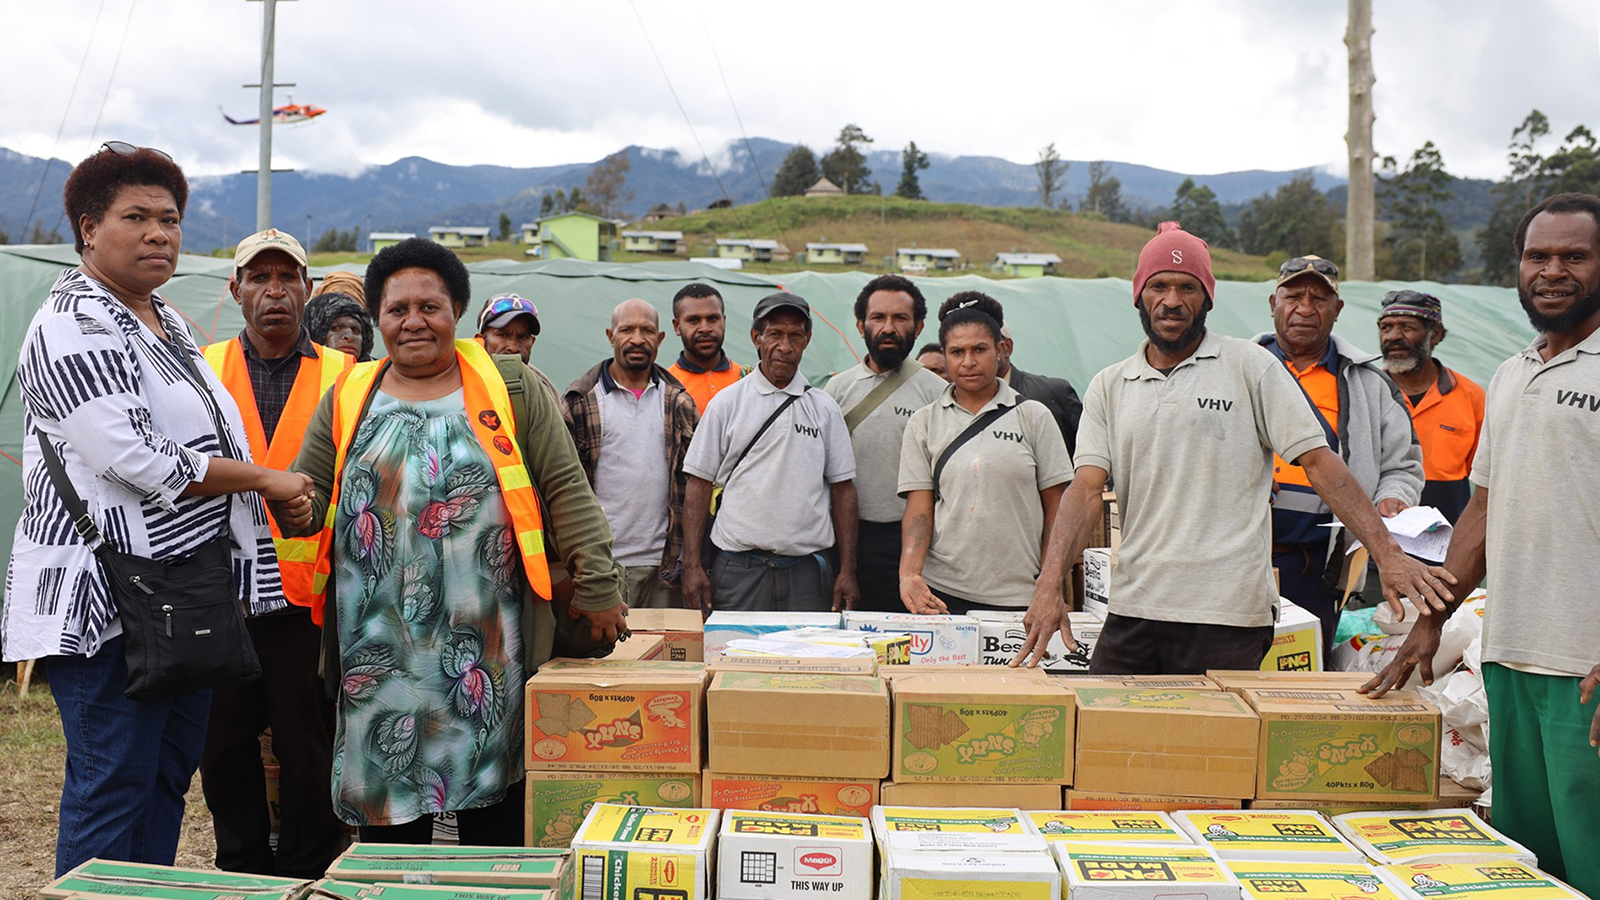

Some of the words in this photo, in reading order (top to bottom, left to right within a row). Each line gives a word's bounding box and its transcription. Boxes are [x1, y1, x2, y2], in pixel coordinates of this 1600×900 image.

[1171, 249, 1184, 264] S
[1197, 398, 1233, 413] VHV
[1557, 389, 1600, 412] VHV
[894, 406, 915, 417] VH
[794, 423, 819, 439] VHV
[993, 431, 1023, 443] VHV
[983, 636, 1031, 653] Bes
[921, 656, 937, 664] Only
[1280, 653, 1309, 670] PNG
[589, 694, 604, 702] 80g
[959, 708, 975, 717] 80g
[981, 709, 1008, 717] 40Pkts
[586, 720, 641, 749] SNAX
[958, 735, 1015, 763] SNAX
[1318, 736, 1376, 763] SNAX
[1325, 781, 1352, 789] 40Pkts
[1359, 781, 1375, 790] 80g
[1397, 819, 1471, 832] PNG
[804, 856, 833, 865] Maggi
[1084, 861, 1163, 869] MADE
[1088, 869, 1169, 880] PNG
[791, 880, 810, 891] THIS
[811, 881, 830, 892] WAY
[831, 882, 844, 892] UP
[1449, 883, 1498, 892] Chicken
